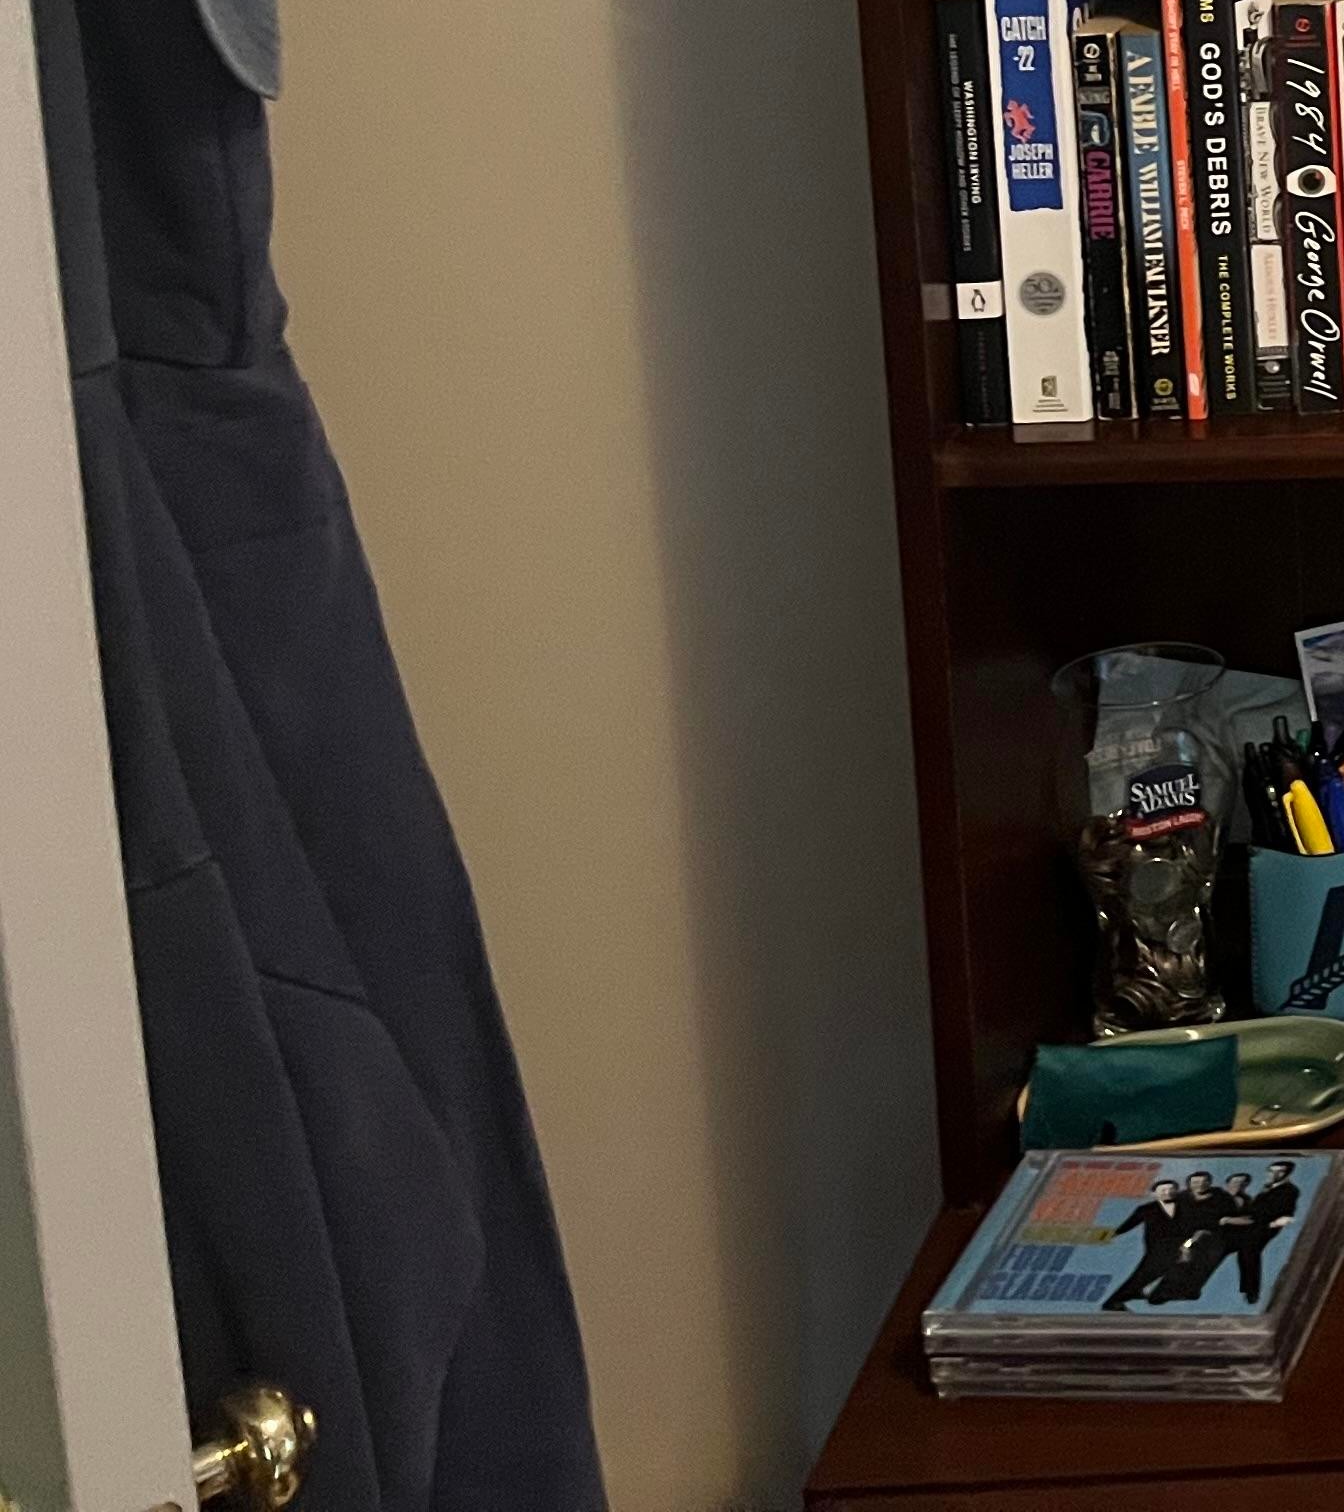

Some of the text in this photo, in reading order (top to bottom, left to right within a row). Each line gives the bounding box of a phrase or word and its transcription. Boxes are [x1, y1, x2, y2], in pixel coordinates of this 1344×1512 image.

[1000, 16, 1047, 41] CATCH
[1199, 42, 1225, 126] GOD'S
[1286, 58, 1327, 155] 1984
[1008, 143, 1054, 161] JOSEPH
[1012, 162, 1054, 179] HELLER
[1206, 137, 1232, 236] DEBRIS
[1139, 162, 1171, 356] WILLIAM FAULKNER
[1219, 283, 1234, 350] COMPLETE
[1294, 211, 1340, 401] George Orwell
[1131, 774, 1200, 802] SAMUEL
[1141, 791, 1195, 813] ADAMS
